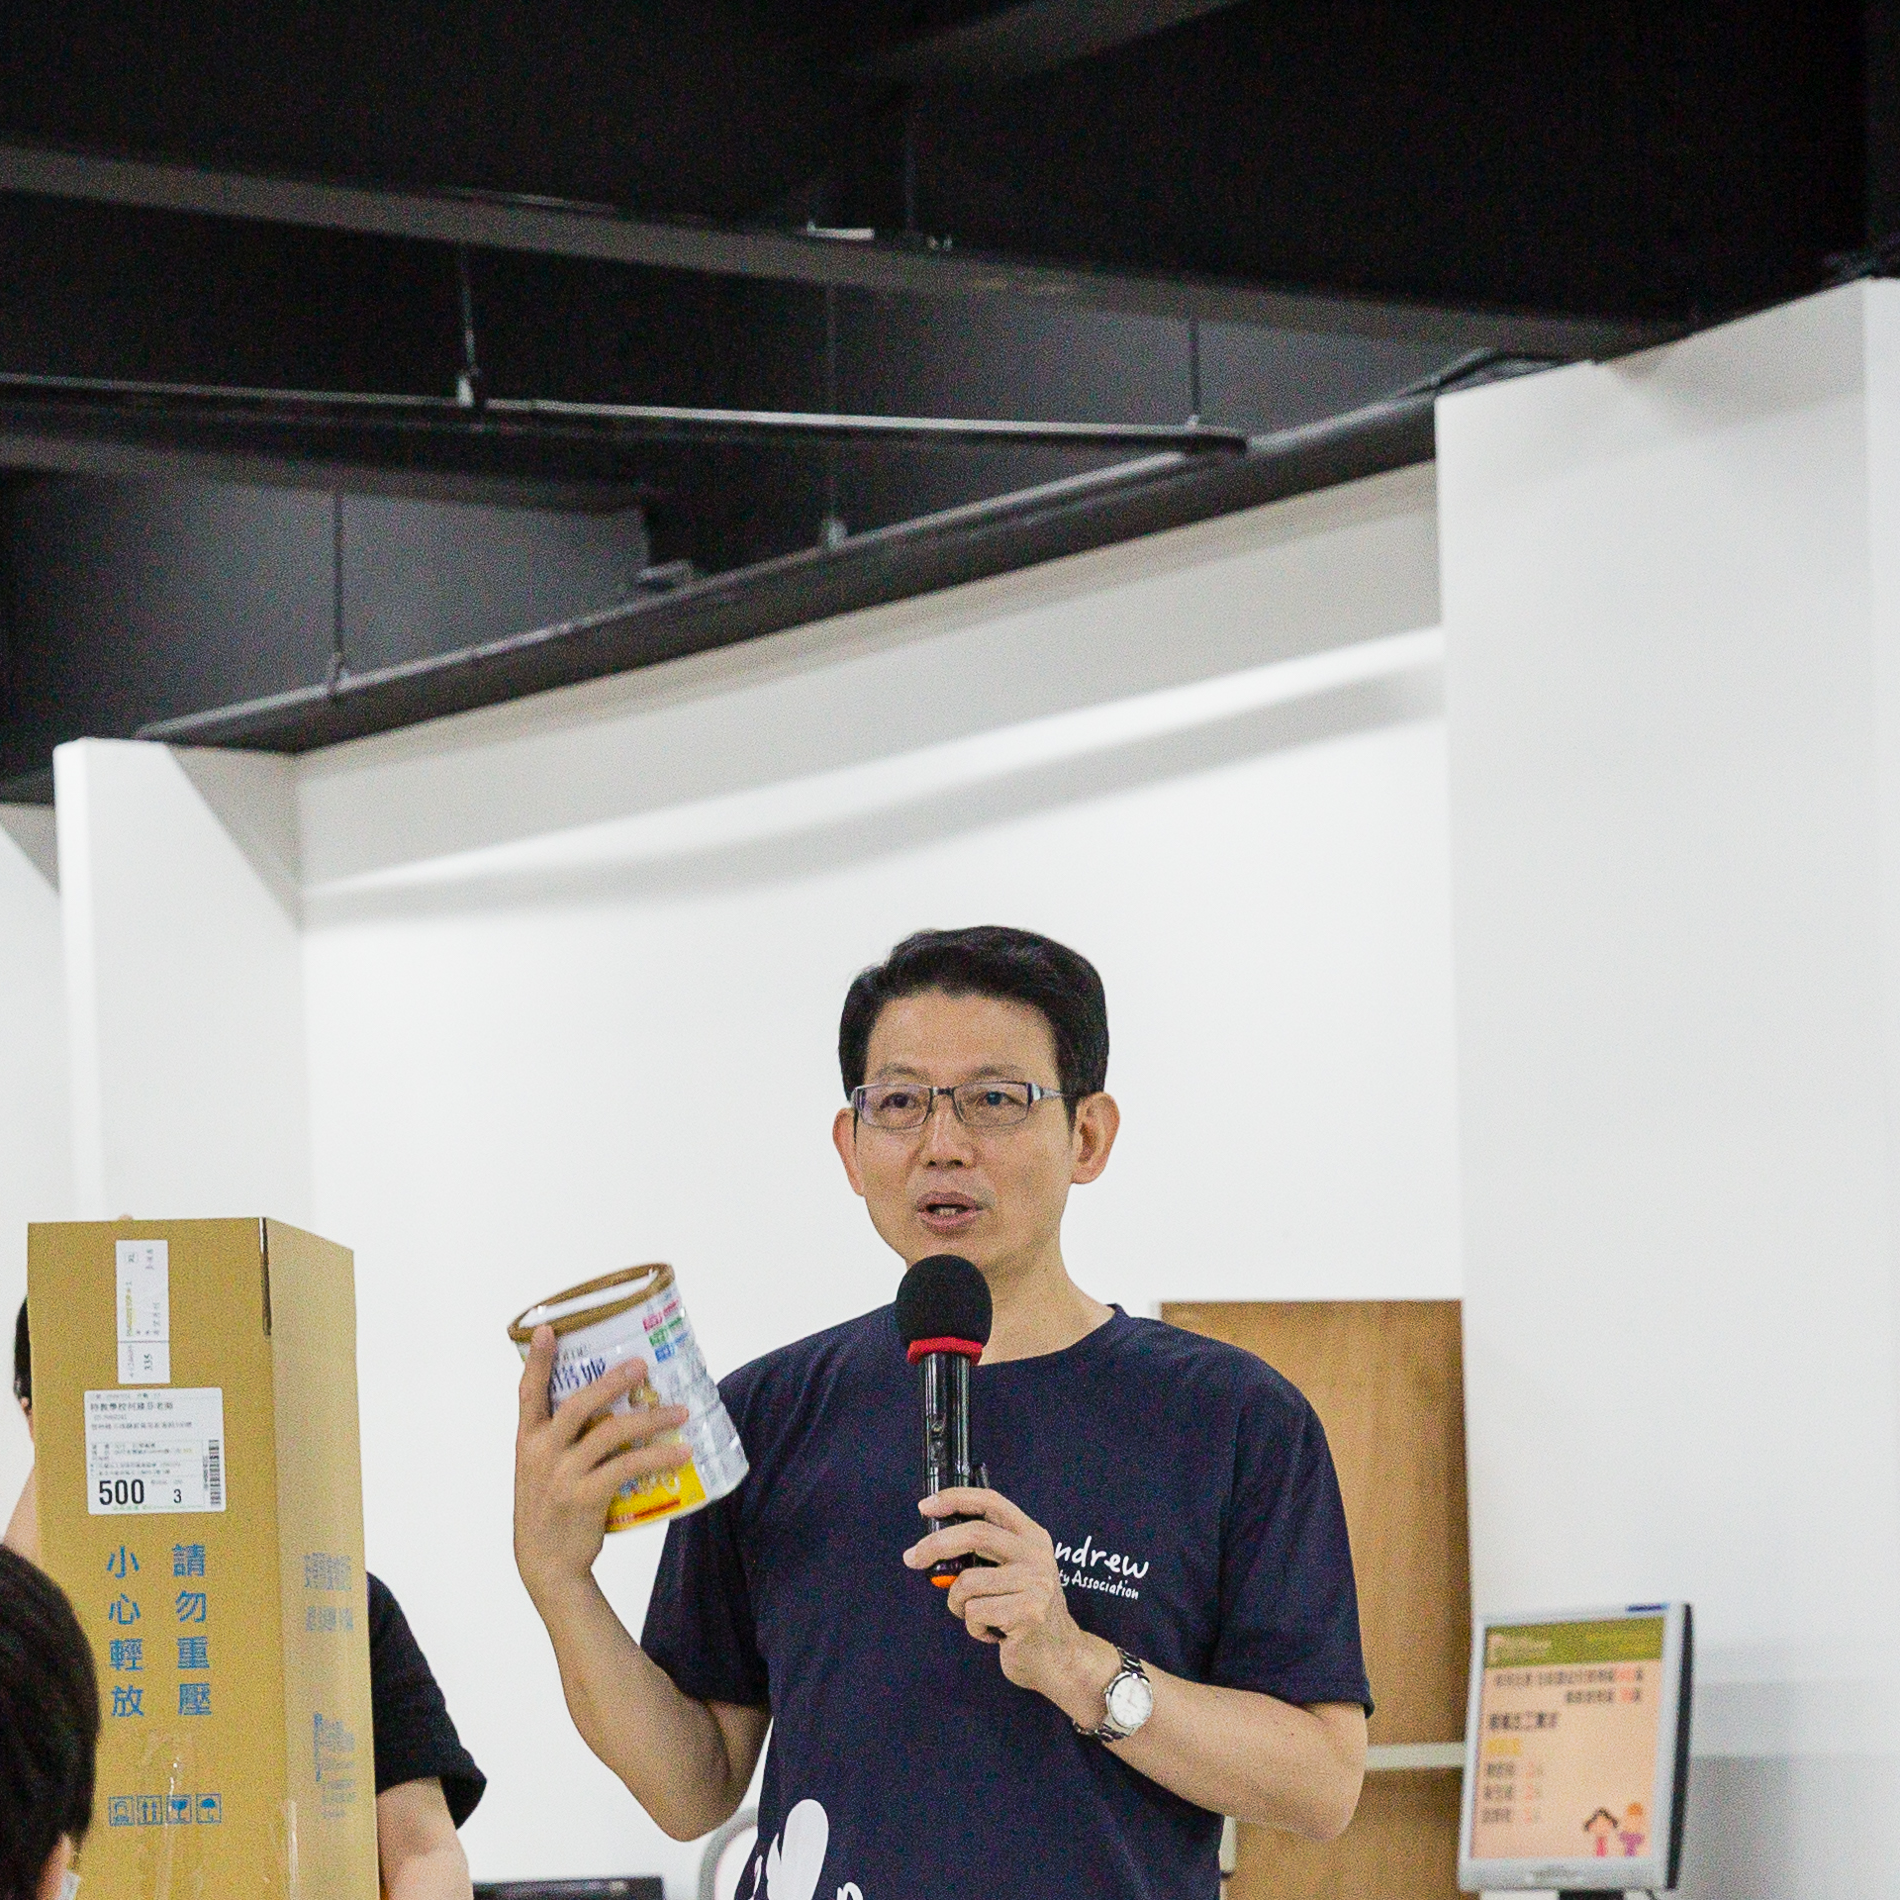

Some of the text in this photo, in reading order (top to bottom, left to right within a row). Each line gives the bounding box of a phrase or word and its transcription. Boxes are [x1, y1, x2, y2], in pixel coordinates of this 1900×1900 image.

[99, 1479, 145, 1505] 500
[173, 1488, 182, 1504] 3
[1054, 1535, 1149, 1579] ndrew
[1071, 1569, 1139, 1601] Association
[106, 1545, 144, 1717] 小心輕放
[172, 1543, 212, 1716] 請勿重壓
